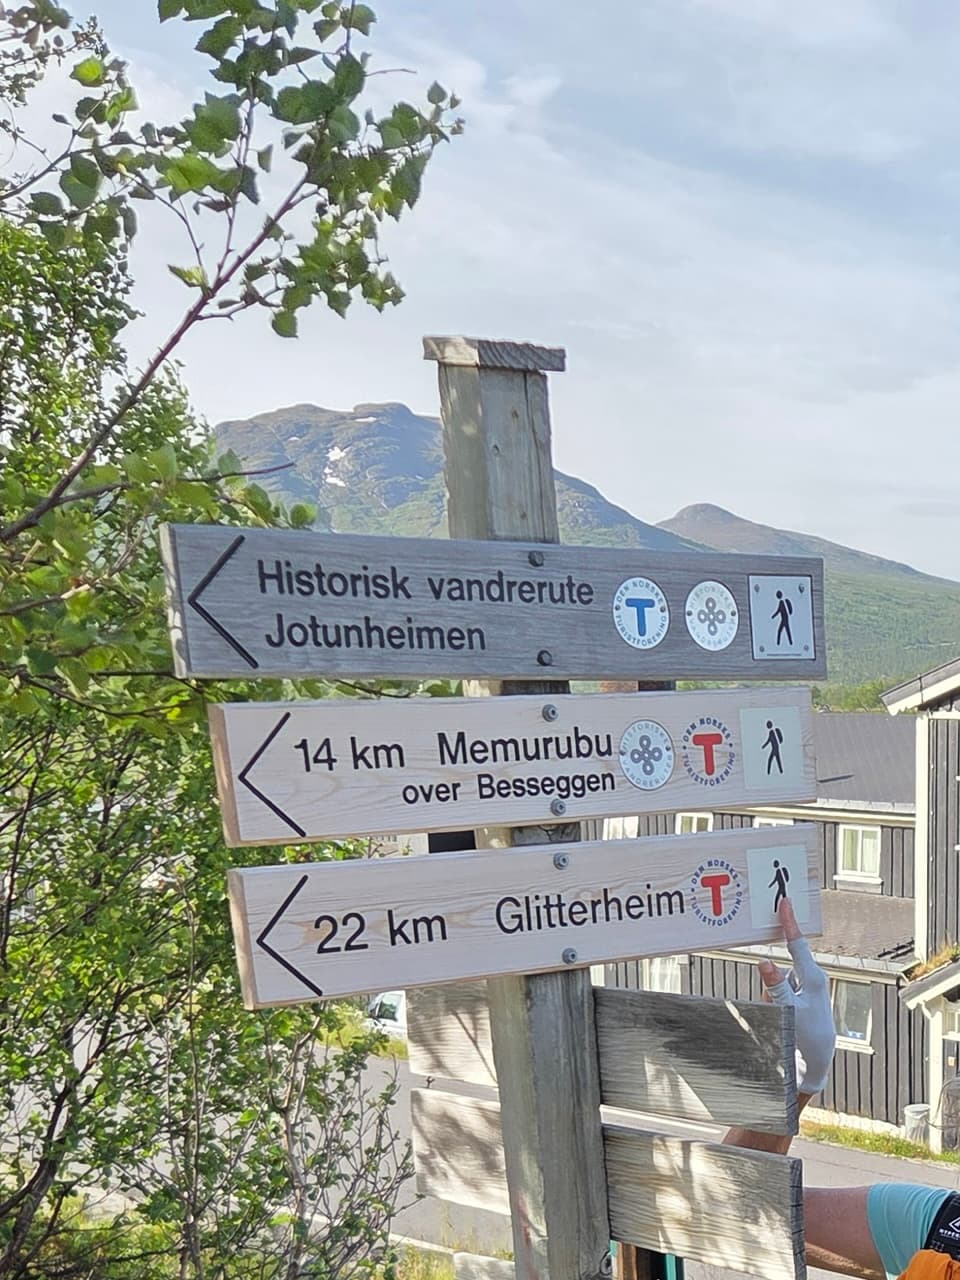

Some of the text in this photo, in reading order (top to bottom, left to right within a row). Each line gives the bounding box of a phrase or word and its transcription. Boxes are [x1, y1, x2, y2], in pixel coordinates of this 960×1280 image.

[257, 559, 595, 606] Historisk vandrerute
[616, 579, 665, 604] DEN NORSKE
[264, 613, 487, 650] Jotunheimen
[614, 614, 668, 648] TURISTFORENING
[624, 598, 656, 637] T
[682, 717, 732, 743] DEN NORSKE
[293, 726, 614, 773] 14 km Memurubu
[692, 733, 724, 777] T
[681, 751, 736, 787] TURISTFORENING
[401, 771, 616, 805] over Besseggen
[690, 859, 739, 885] DEN NORSKE
[690, 891, 743, 927] TURISTFORENING
[700, 873, 731, 917] T
[313, 883, 686, 955] 22 km Glitterheim
